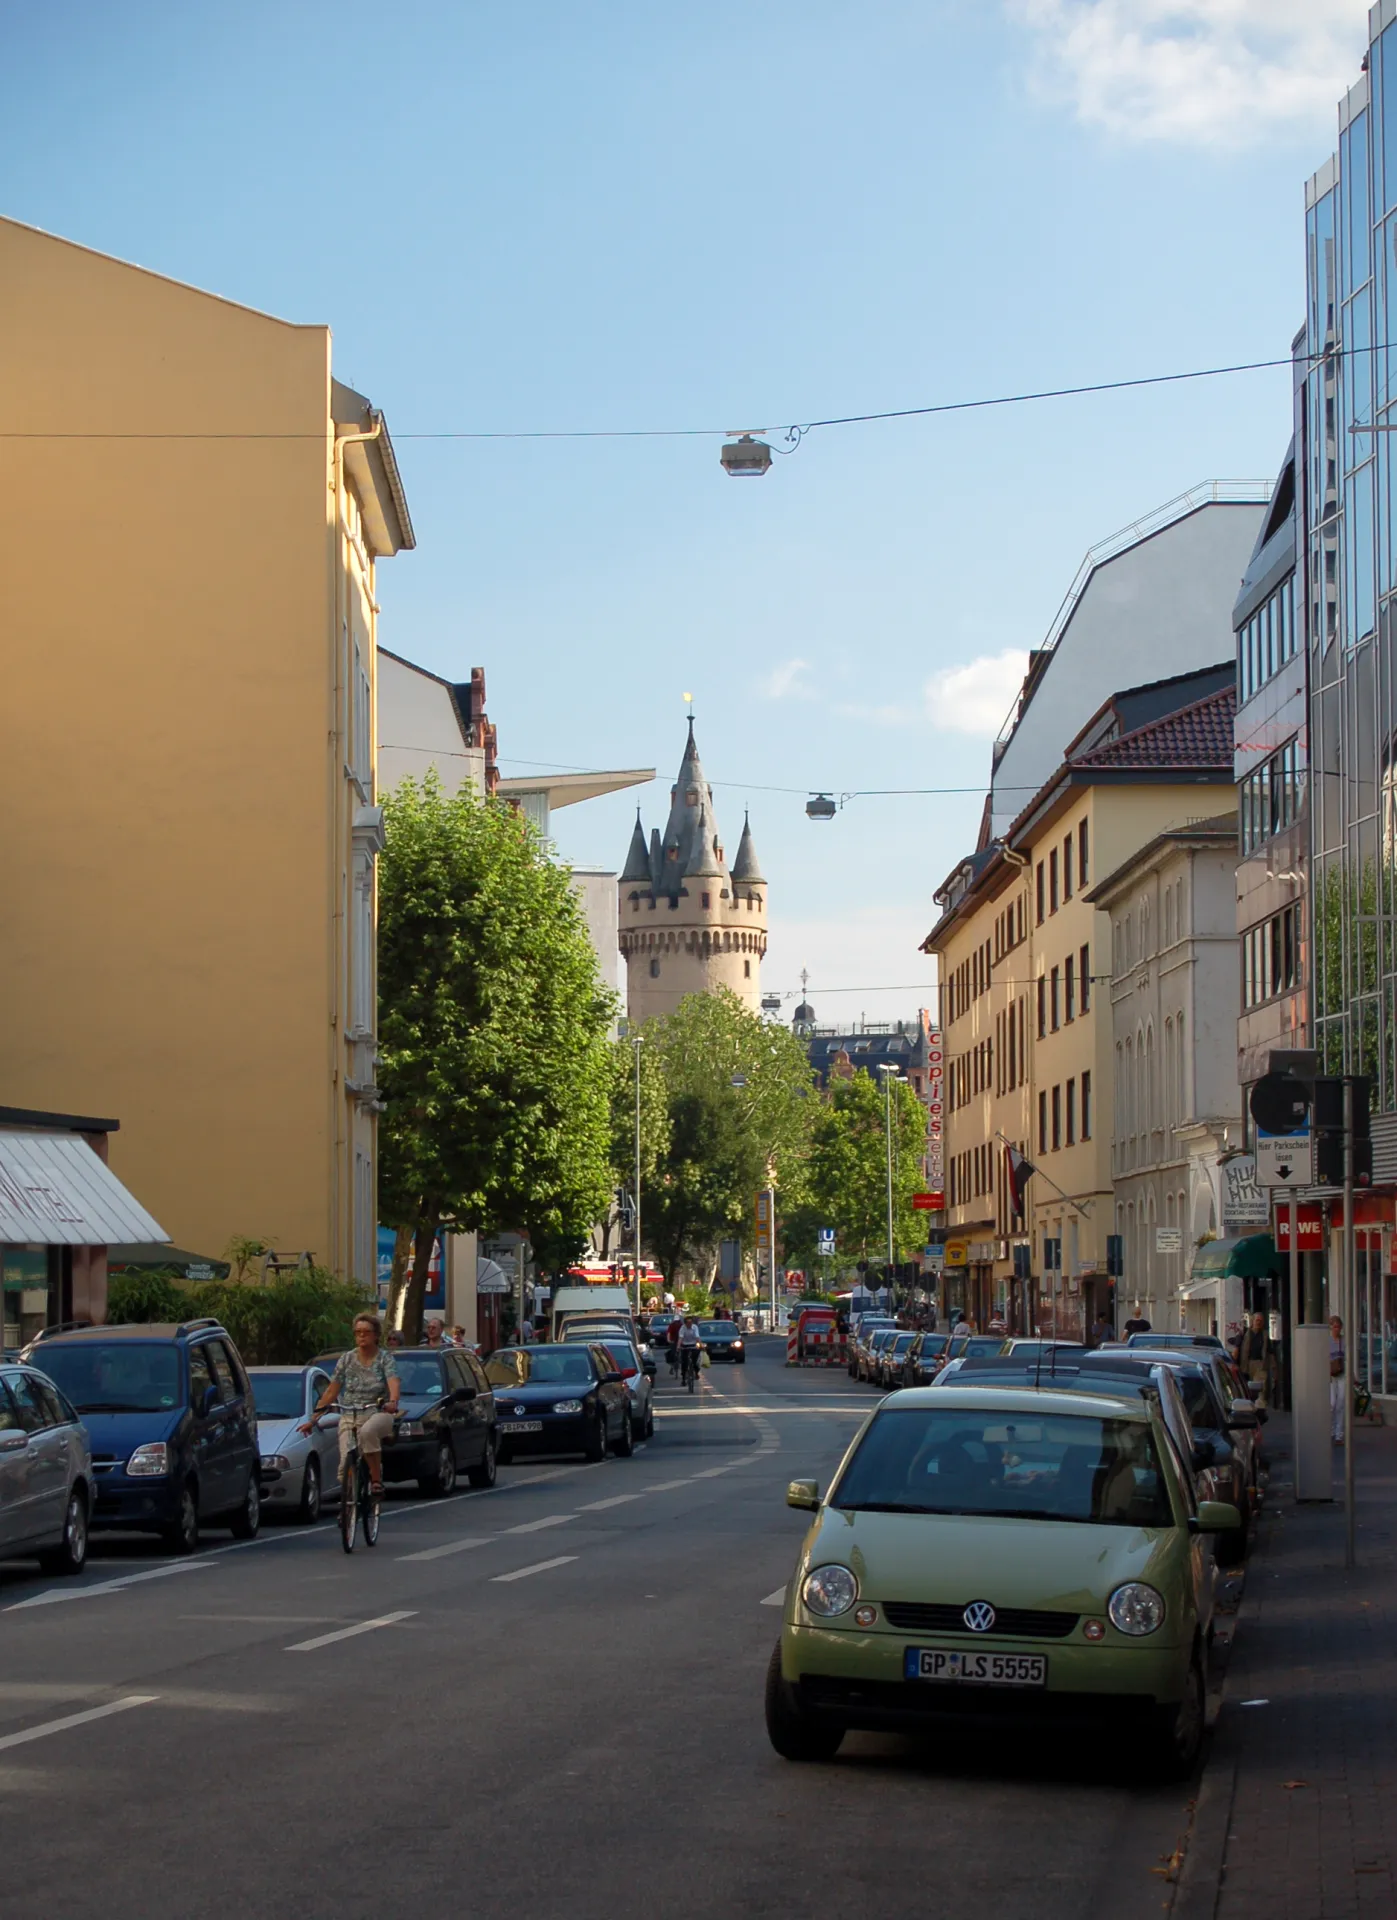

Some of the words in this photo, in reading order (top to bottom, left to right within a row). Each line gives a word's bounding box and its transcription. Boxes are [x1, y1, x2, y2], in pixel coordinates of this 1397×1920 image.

[928, 1032, 943, 1133] copies
[1258, 1141, 1271, 1150] Hier
[1274, 1139, 1309, 1149] Parkschein
[1275, 1151, 1293, 1162] lösen
[1279, 1221, 1321, 1235] RWE
[823, 1229, 834, 1241] U
[920, 1652, 946, 1675] GP
[961, 1655, 988, 1679] LS
[992, 1657, 1043, 1681] 5555
